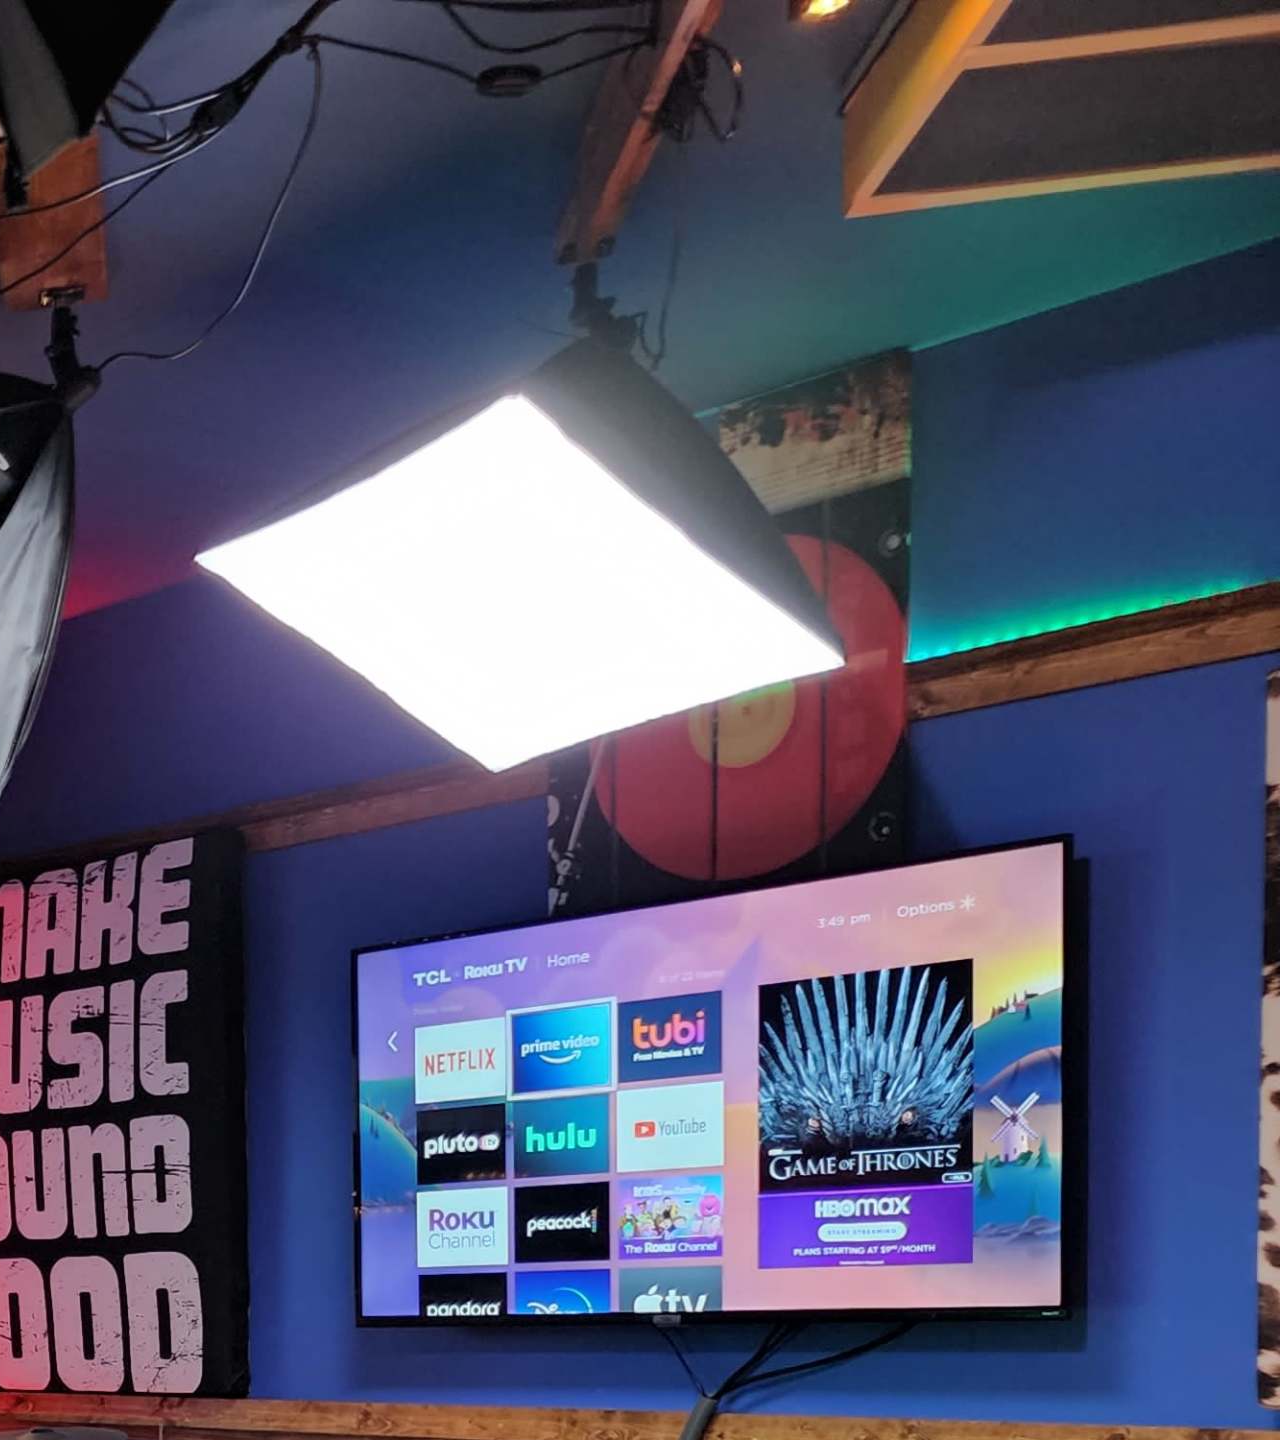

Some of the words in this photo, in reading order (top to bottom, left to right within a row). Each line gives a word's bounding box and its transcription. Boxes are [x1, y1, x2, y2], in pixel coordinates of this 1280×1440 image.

[897, 898, 955, 918] Options
[850, 912, 871, 926] pm
[547, 951, 590, 968] Home
[413, 970, 452, 986] TCL
[505, 957, 529, 974] TV
[633, 1009, 705, 1049] tubi
[521, 1036, 560, 1057] prime
[562, 1034, 600, 1050] video
[424, 1047, 496, 1076] NETFLIX
[526, 1122, 597, 1153] hulu
[659, 1117, 707, 1137] YouTube
[424, 1132, 478, 1159] pluto
[768, 1155, 837, 1181] GAME
[851, 1144, 961, 1175] THRONES
[526, 1209, 591, 1238] peacock
[428, 1231, 496, 1251] Channel
[678, 1241, 718, 1252] Channel
[793, 1247, 821, 1256] PLANS
[823, 1246, 865, 1256] STARTING
[866, 1245, 879, 1255] AT
[426, 1300, 501, 1316] pandora
